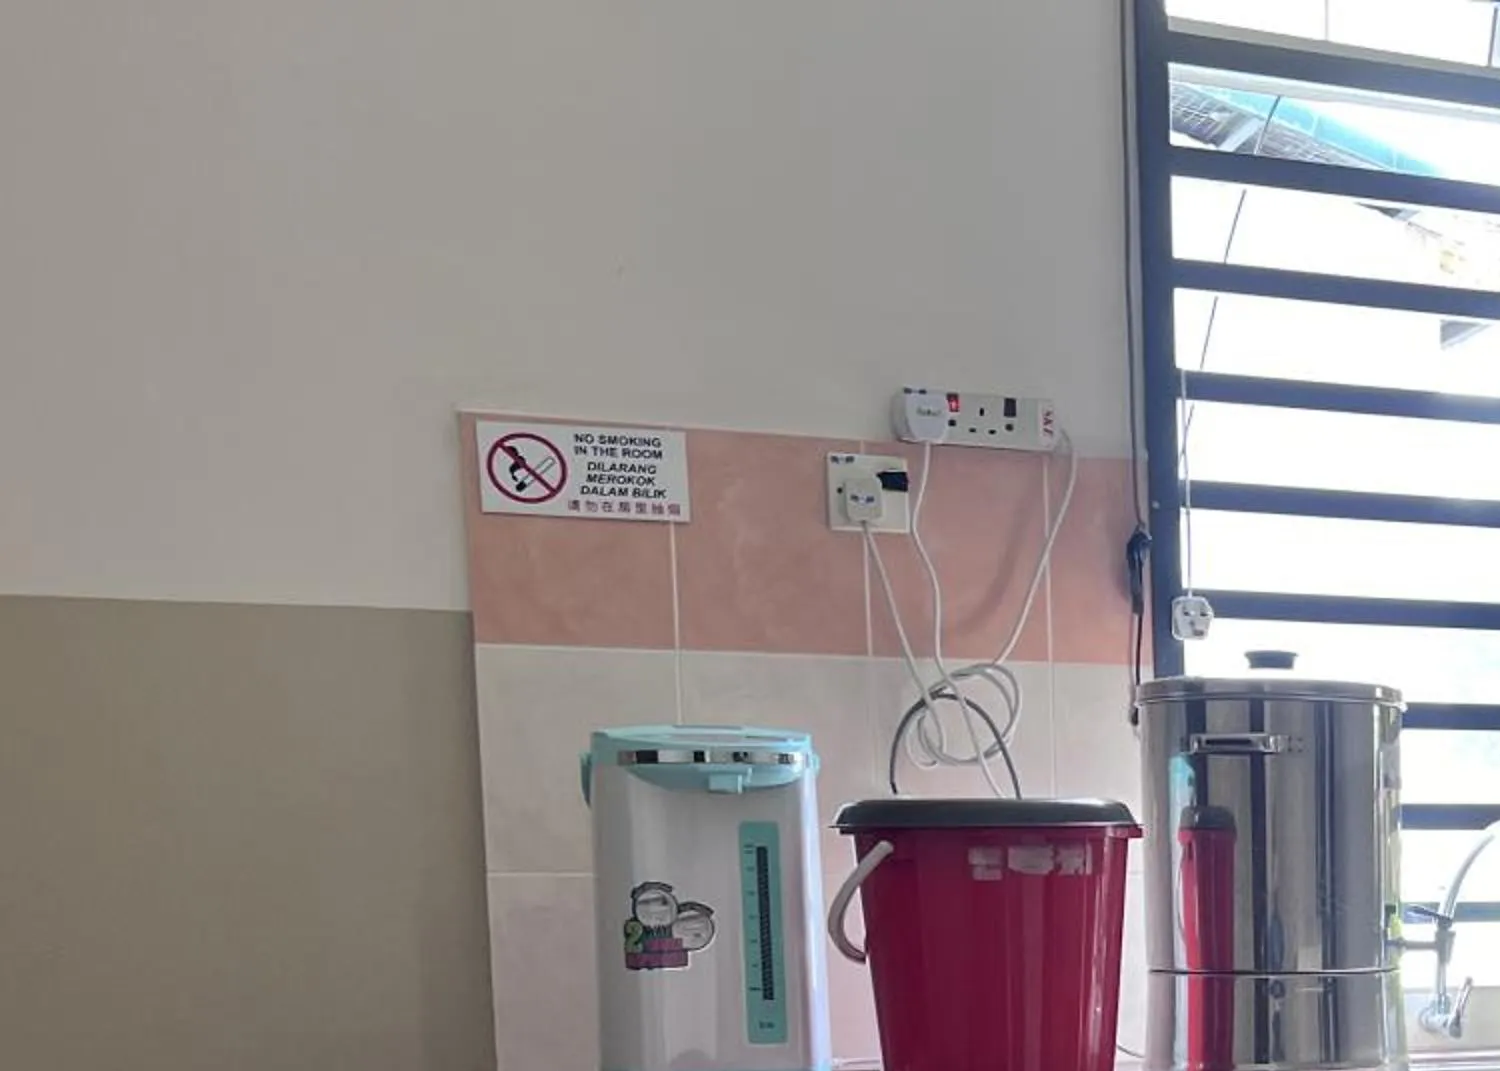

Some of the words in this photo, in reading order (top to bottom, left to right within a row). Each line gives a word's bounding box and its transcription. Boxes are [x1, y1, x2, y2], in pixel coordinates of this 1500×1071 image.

[574, 433, 594, 445] NO
[597, 434, 662, 448] SMOKING
[574, 446, 587, 455] IN
[591, 446, 618, 457] THE
[621, 447, 663, 459] ROOM
[587, 461, 657, 475] DILARANG
[586, 473, 656, 487] MEROKOK
[581, 485, 629, 496] DALAM
[632, 487, 667, 499] BILIK
